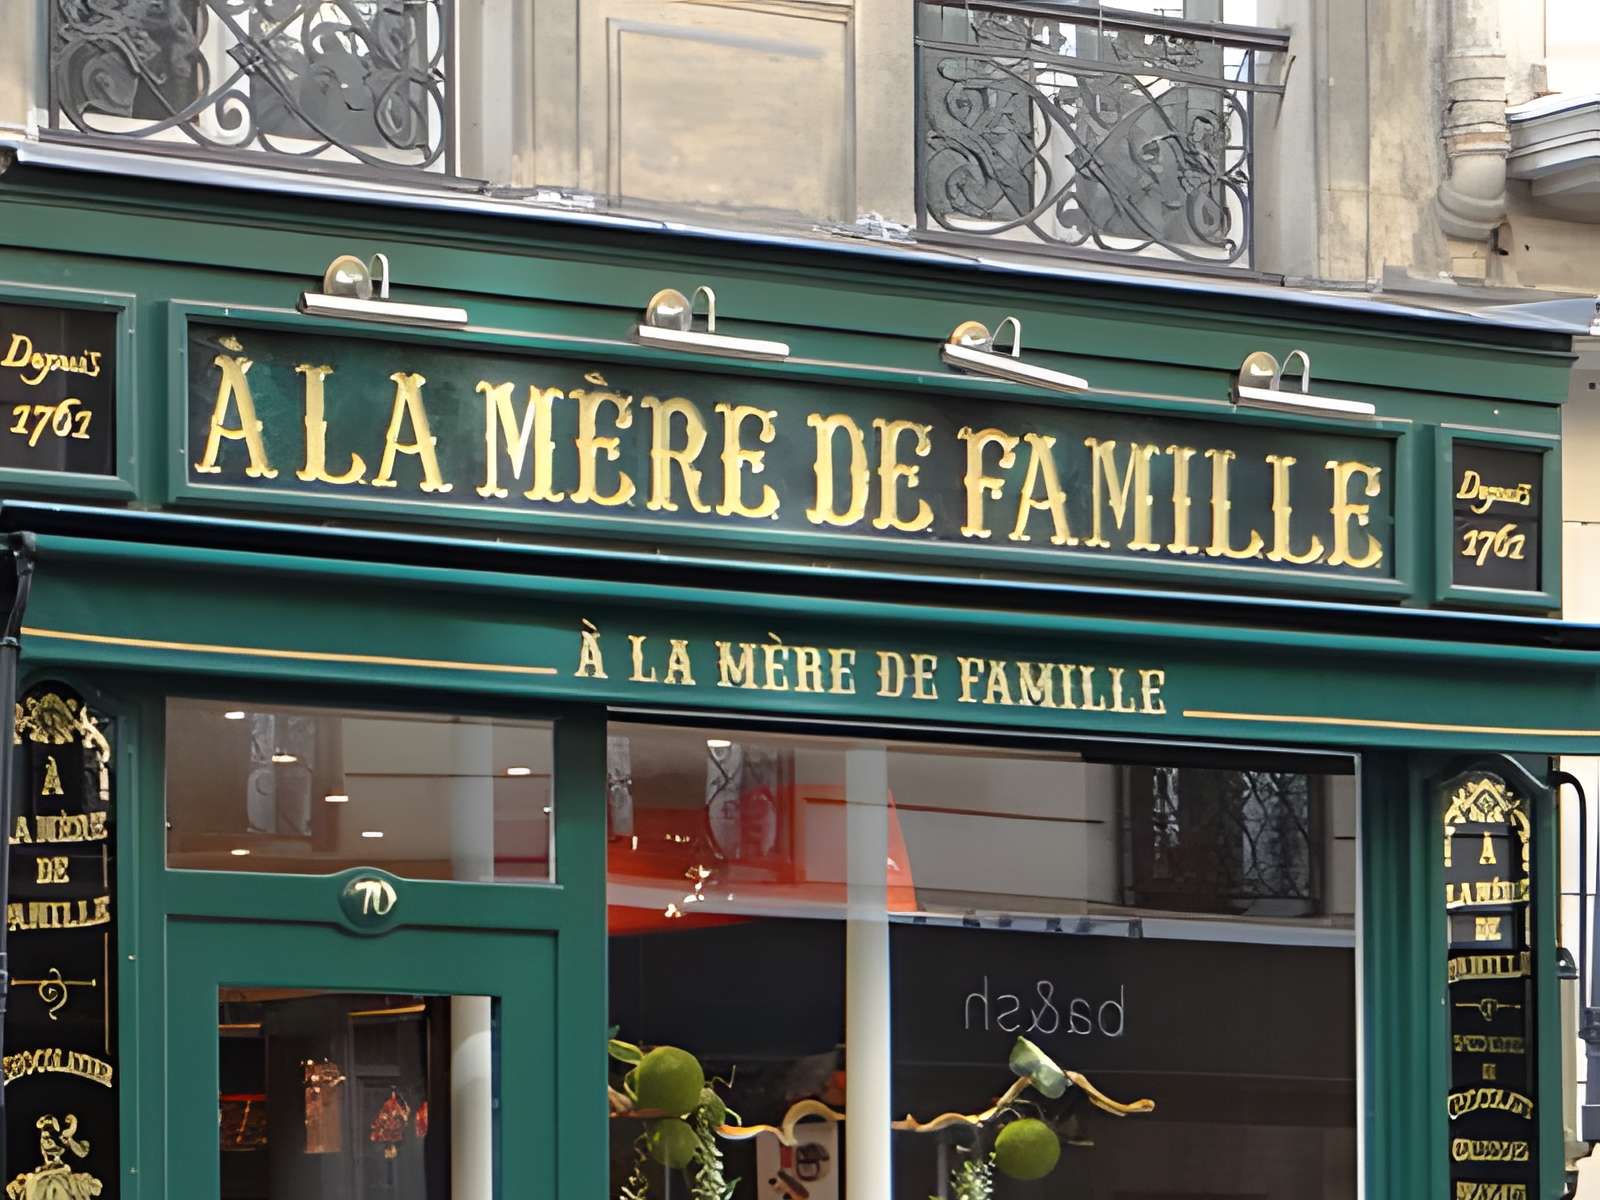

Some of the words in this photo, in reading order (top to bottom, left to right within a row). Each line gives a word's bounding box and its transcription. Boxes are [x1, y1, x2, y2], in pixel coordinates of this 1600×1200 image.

[9, 398, 93, 447] 1761
[193, 336, 279, 478] À
[295, 363, 453, 493] LA
[475, 371, 779, 520] MÈRE
[806, 412, 935, 532] DE
[956, 425, 1384, 570] FAMILLE
[1461, 523, 1526, 567] 1761
[574, 617, 608, 679] À
[627, 634, 697, 686] LA
[715, 631, 856, 695] MÈRE
[875, 650, 938, 700] DE
[957, 655, 1167, 715] FAMILLE
[36, 856, 71, 884] DE
